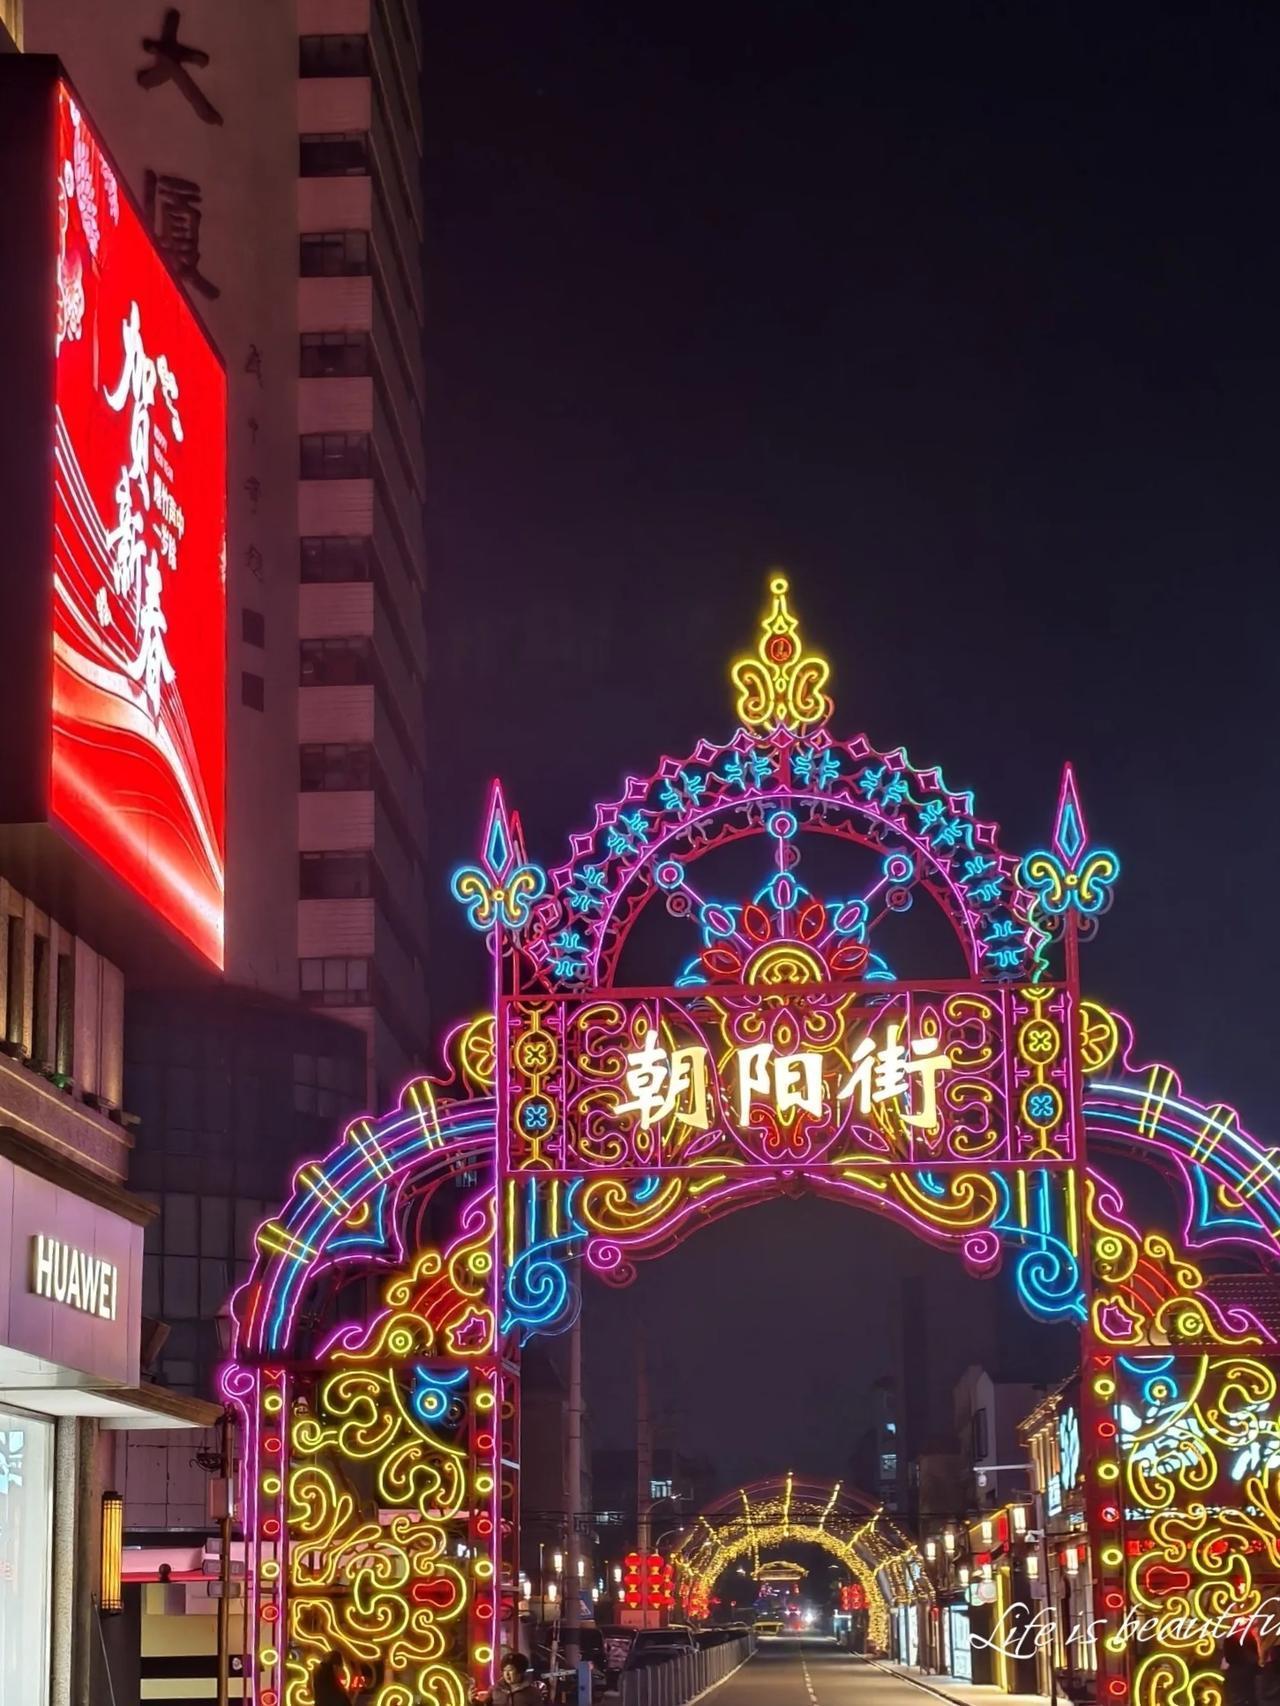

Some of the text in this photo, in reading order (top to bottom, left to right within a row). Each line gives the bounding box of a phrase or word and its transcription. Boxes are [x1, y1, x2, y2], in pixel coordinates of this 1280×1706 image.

[136, 8, 223, 301] 大厦
[613, 1025, 953, 1130] 朝阳街
[36, 1234, 118, 1321] HUAWEI
